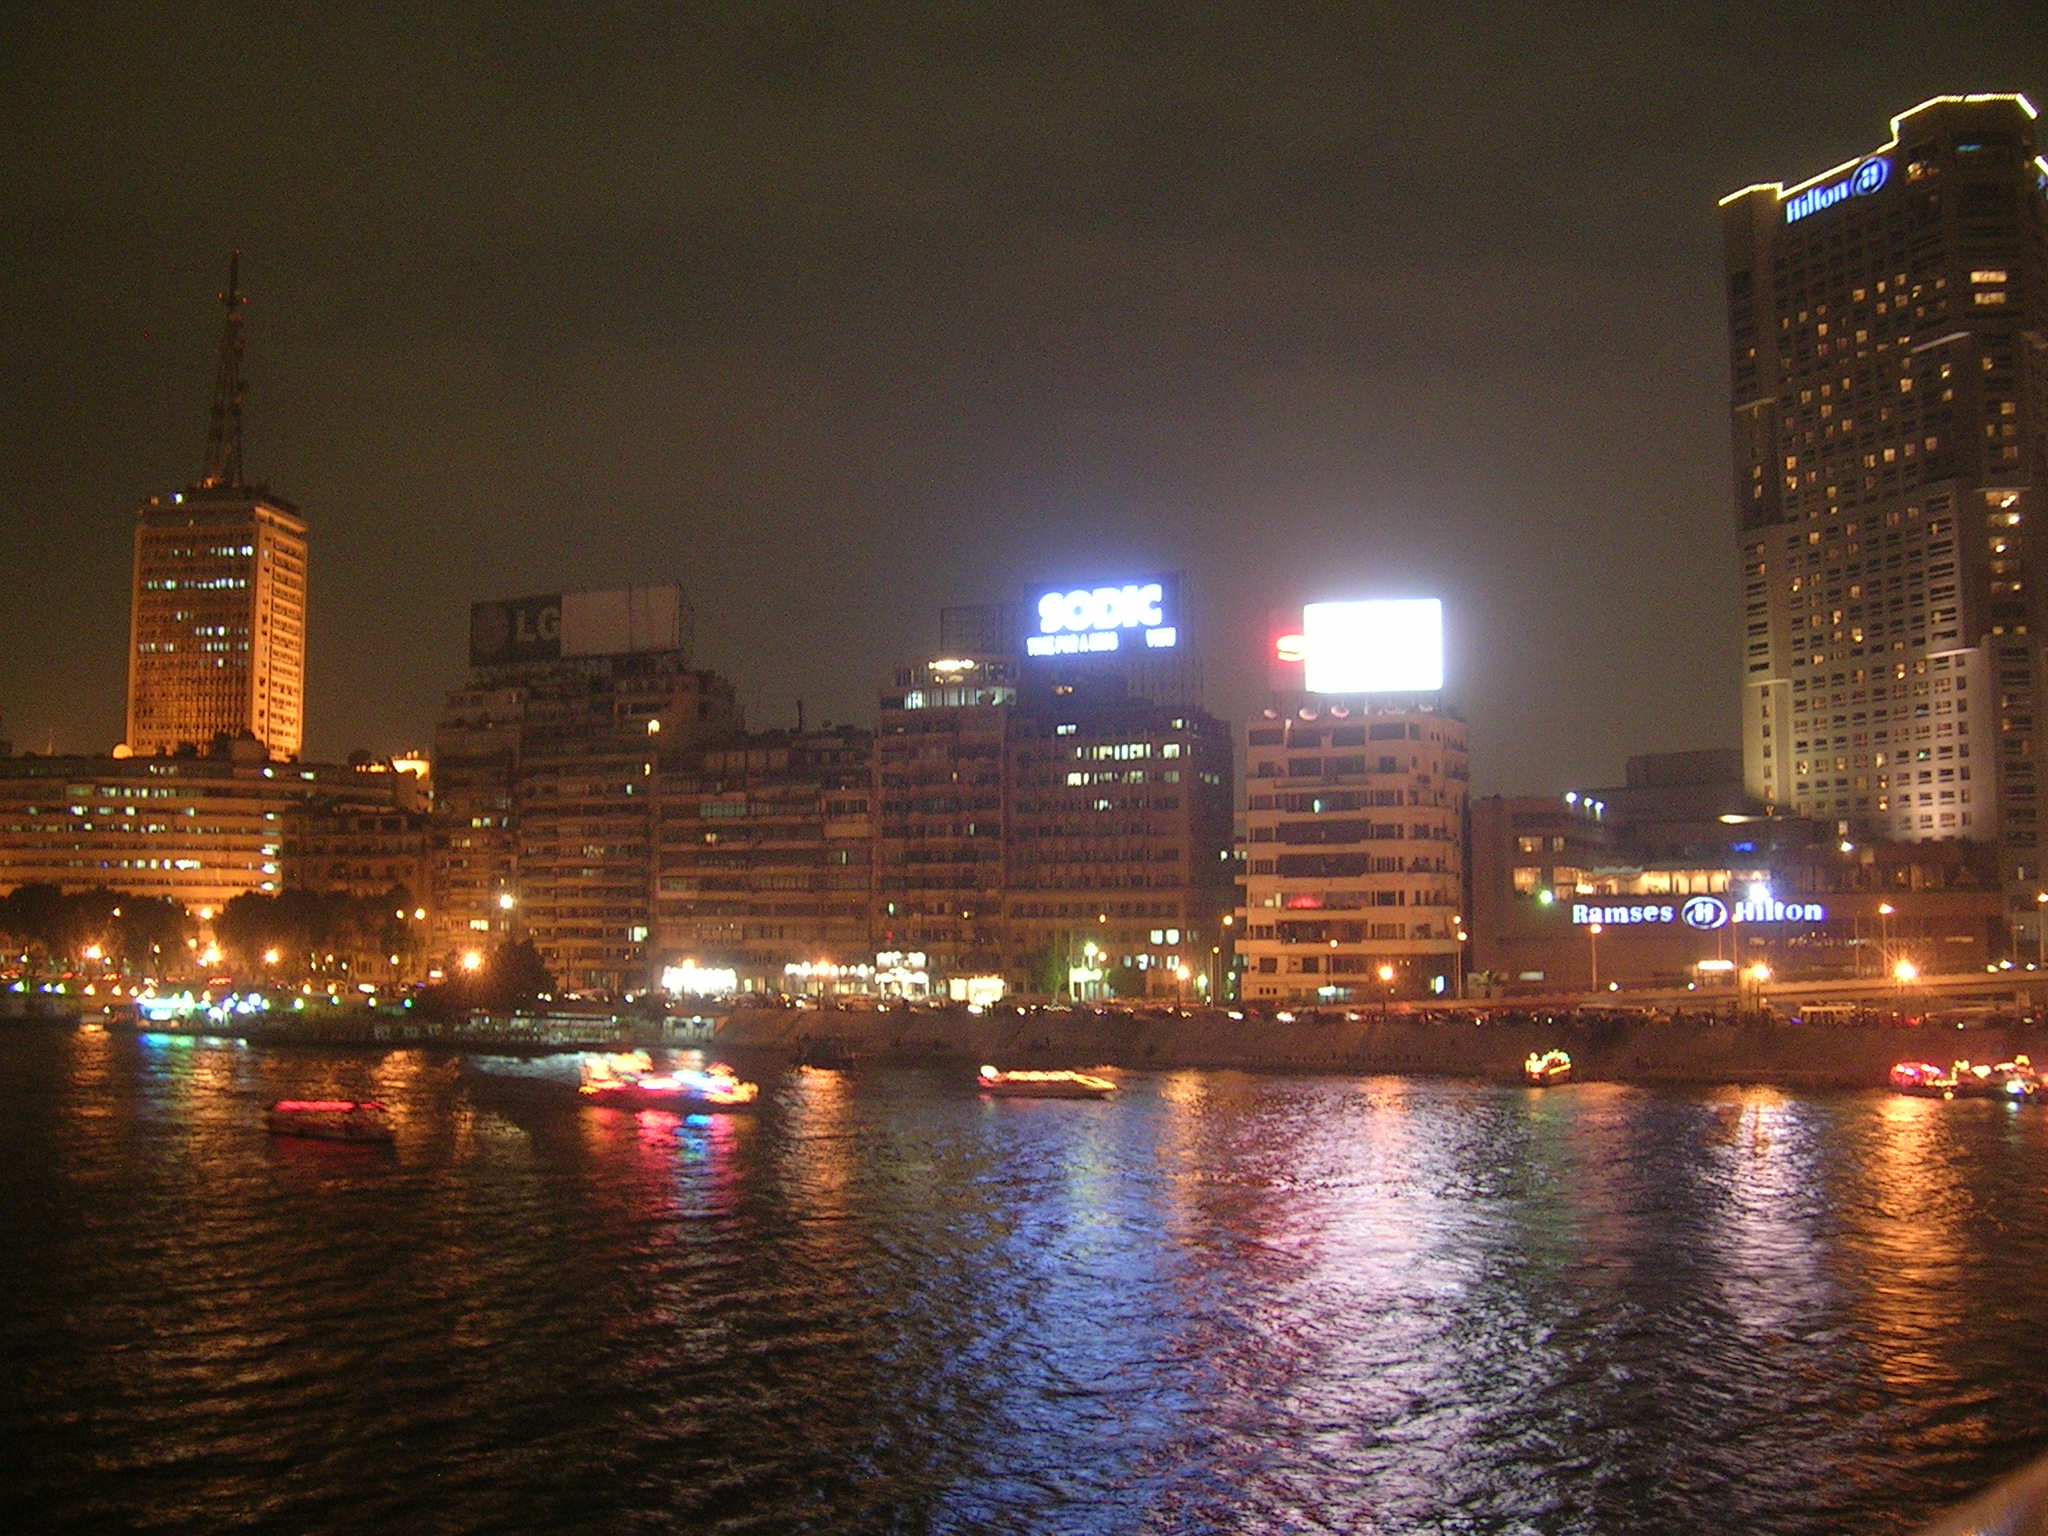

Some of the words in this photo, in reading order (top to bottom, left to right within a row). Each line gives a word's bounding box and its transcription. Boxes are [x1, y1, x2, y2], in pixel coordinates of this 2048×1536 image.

[1786, 180, 1850, 223] Hilton
[515, 605, 561, 643] LG
[1038, 583, 1163, 633] SODIC
[1572, 903, 1674, 925] Ramses
[1735, 899, 1825, 922] Hilton
